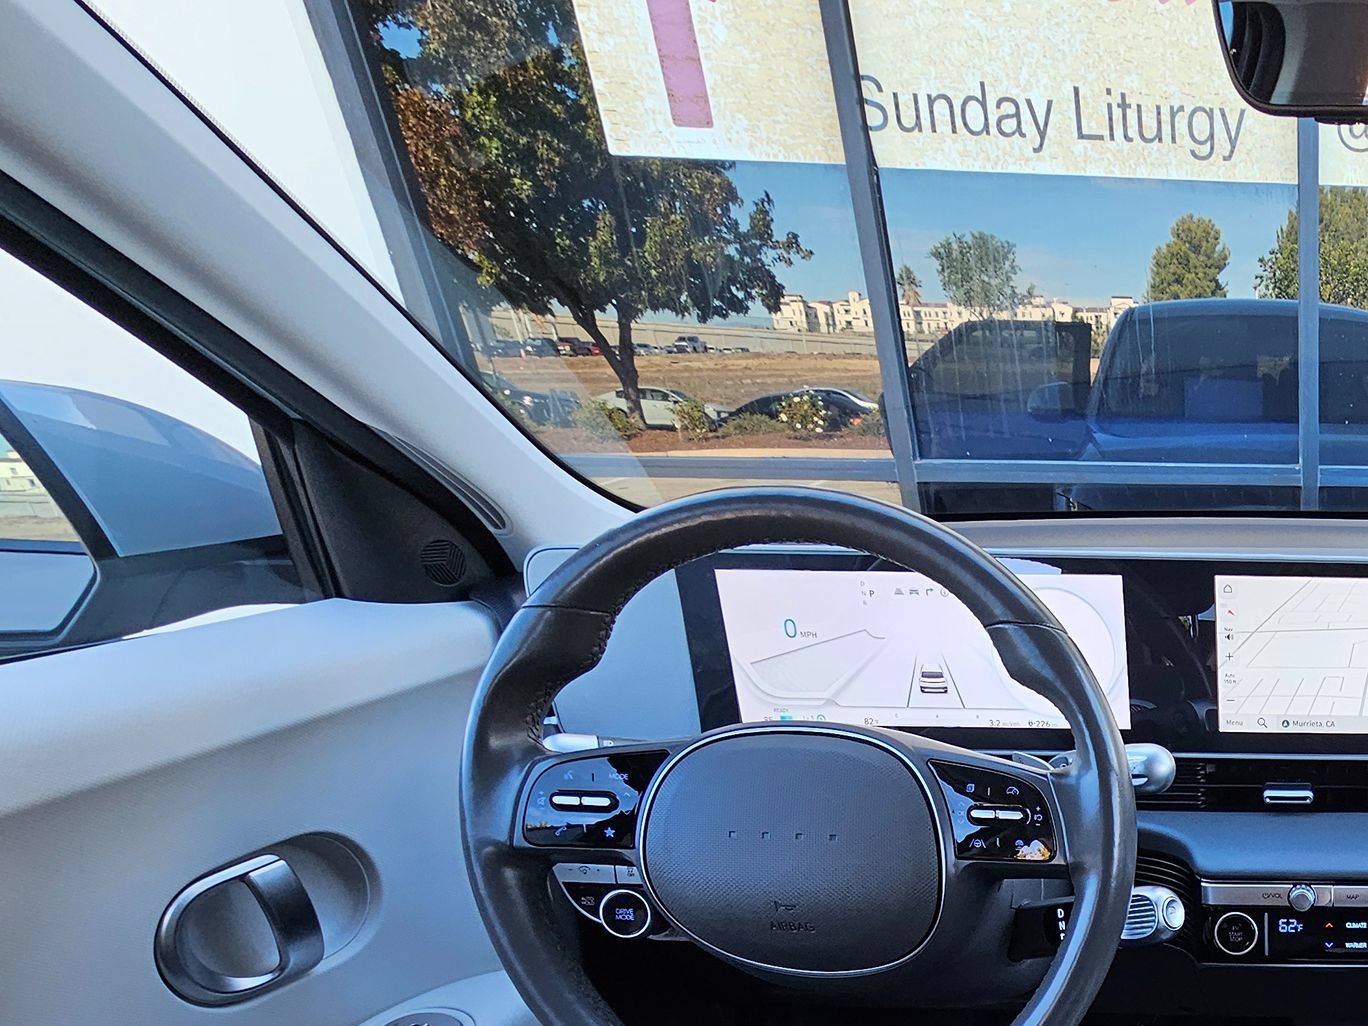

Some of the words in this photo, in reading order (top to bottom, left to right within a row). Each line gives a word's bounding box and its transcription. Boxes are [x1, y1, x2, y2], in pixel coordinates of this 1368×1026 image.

[861, 74, 1053, 154] Sunday
[1073, 86, 1247, 162] Liturgy
[783, 618, 798, 639] 0
[799, 631, 818, 639] MPH
[1226, 719, 1244, 727] Menu
[1325, 720, 1336, 728] CA
[1056, 908, 1065, 919] D
[769, 920, 817, 933] AIRBAG
[1345, 921, 1368, 929] CLIMATE
